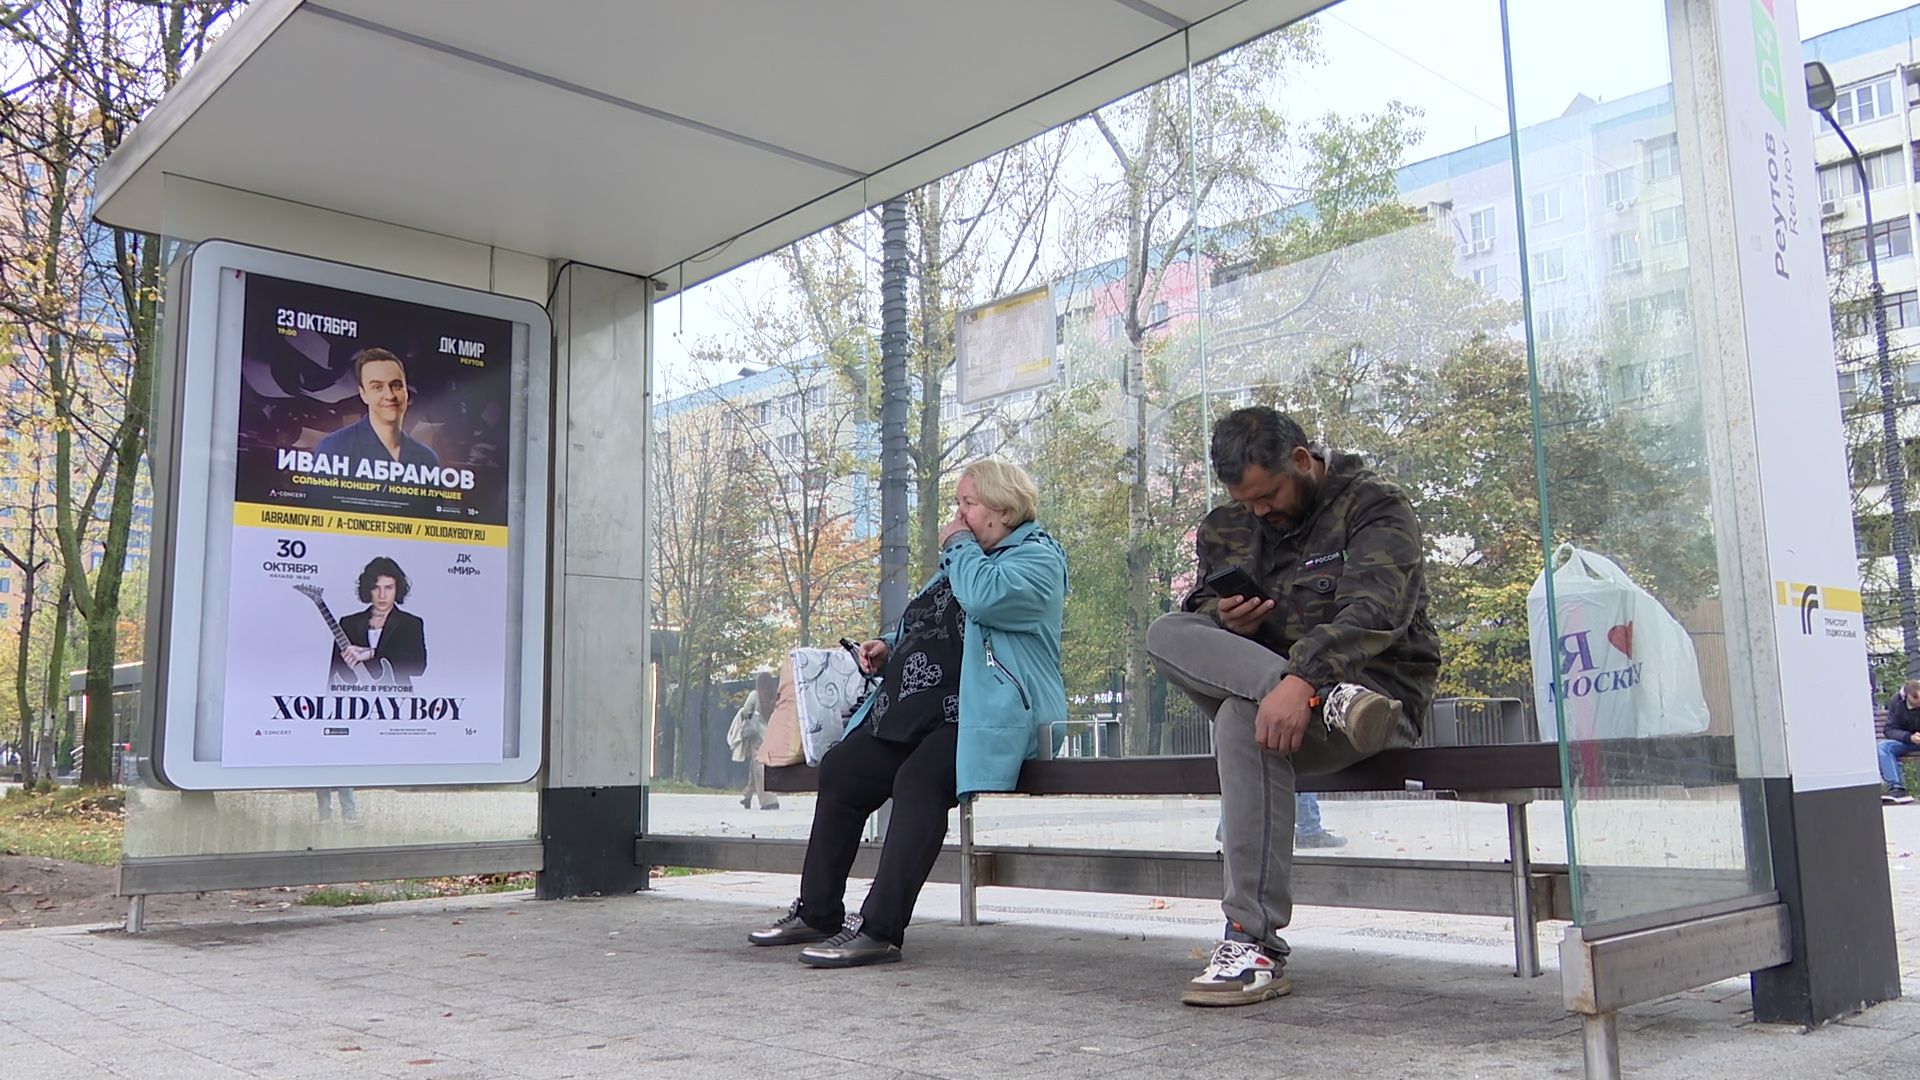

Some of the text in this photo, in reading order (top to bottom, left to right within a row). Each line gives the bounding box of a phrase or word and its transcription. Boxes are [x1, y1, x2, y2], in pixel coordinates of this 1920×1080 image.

[1782, 140, 1799, 235] Reutov
[1765, 132, 1790, 280] Реутов
[277, 308, 357, 338] 23 ОКТЯБРЯ
[438, 336, 485, 358] ДК МИР
[278, 448, 475, 490] ИВАН АБРАМОВ
[292, 475, 339, 488] СОЛЬНЫЙ
[340, 480, 381, 492] КОНЦЕРТ
[389, 485, 420, 496] НОВОЕ
[427, 489, 462, 500] ЛУЧШЕЕ
[261, 510, 324, 528] IABRAMOV.RU
[336, 517, 413, 535] A-CONCERT.SHOW
[424, 525, 486, 541] XOLIDAYBOY.RU
[277, 539, 306, 559] 30
[456, 553, 471, 563] ДК
[1314, 551, 1340, 564] РОССИЯ
[263, 561, 318, 574] ОКТЯБРЯ
[1557, 629, 1601, 675] Я
[331, 684, 369, 692] ВПЕРВЫЕ
[378, 685, 414, 693] РЕУТОВЕ
[271, 695, 466, 720] XOLIDAYBOY
[465, 727, 477, 736] 16+
